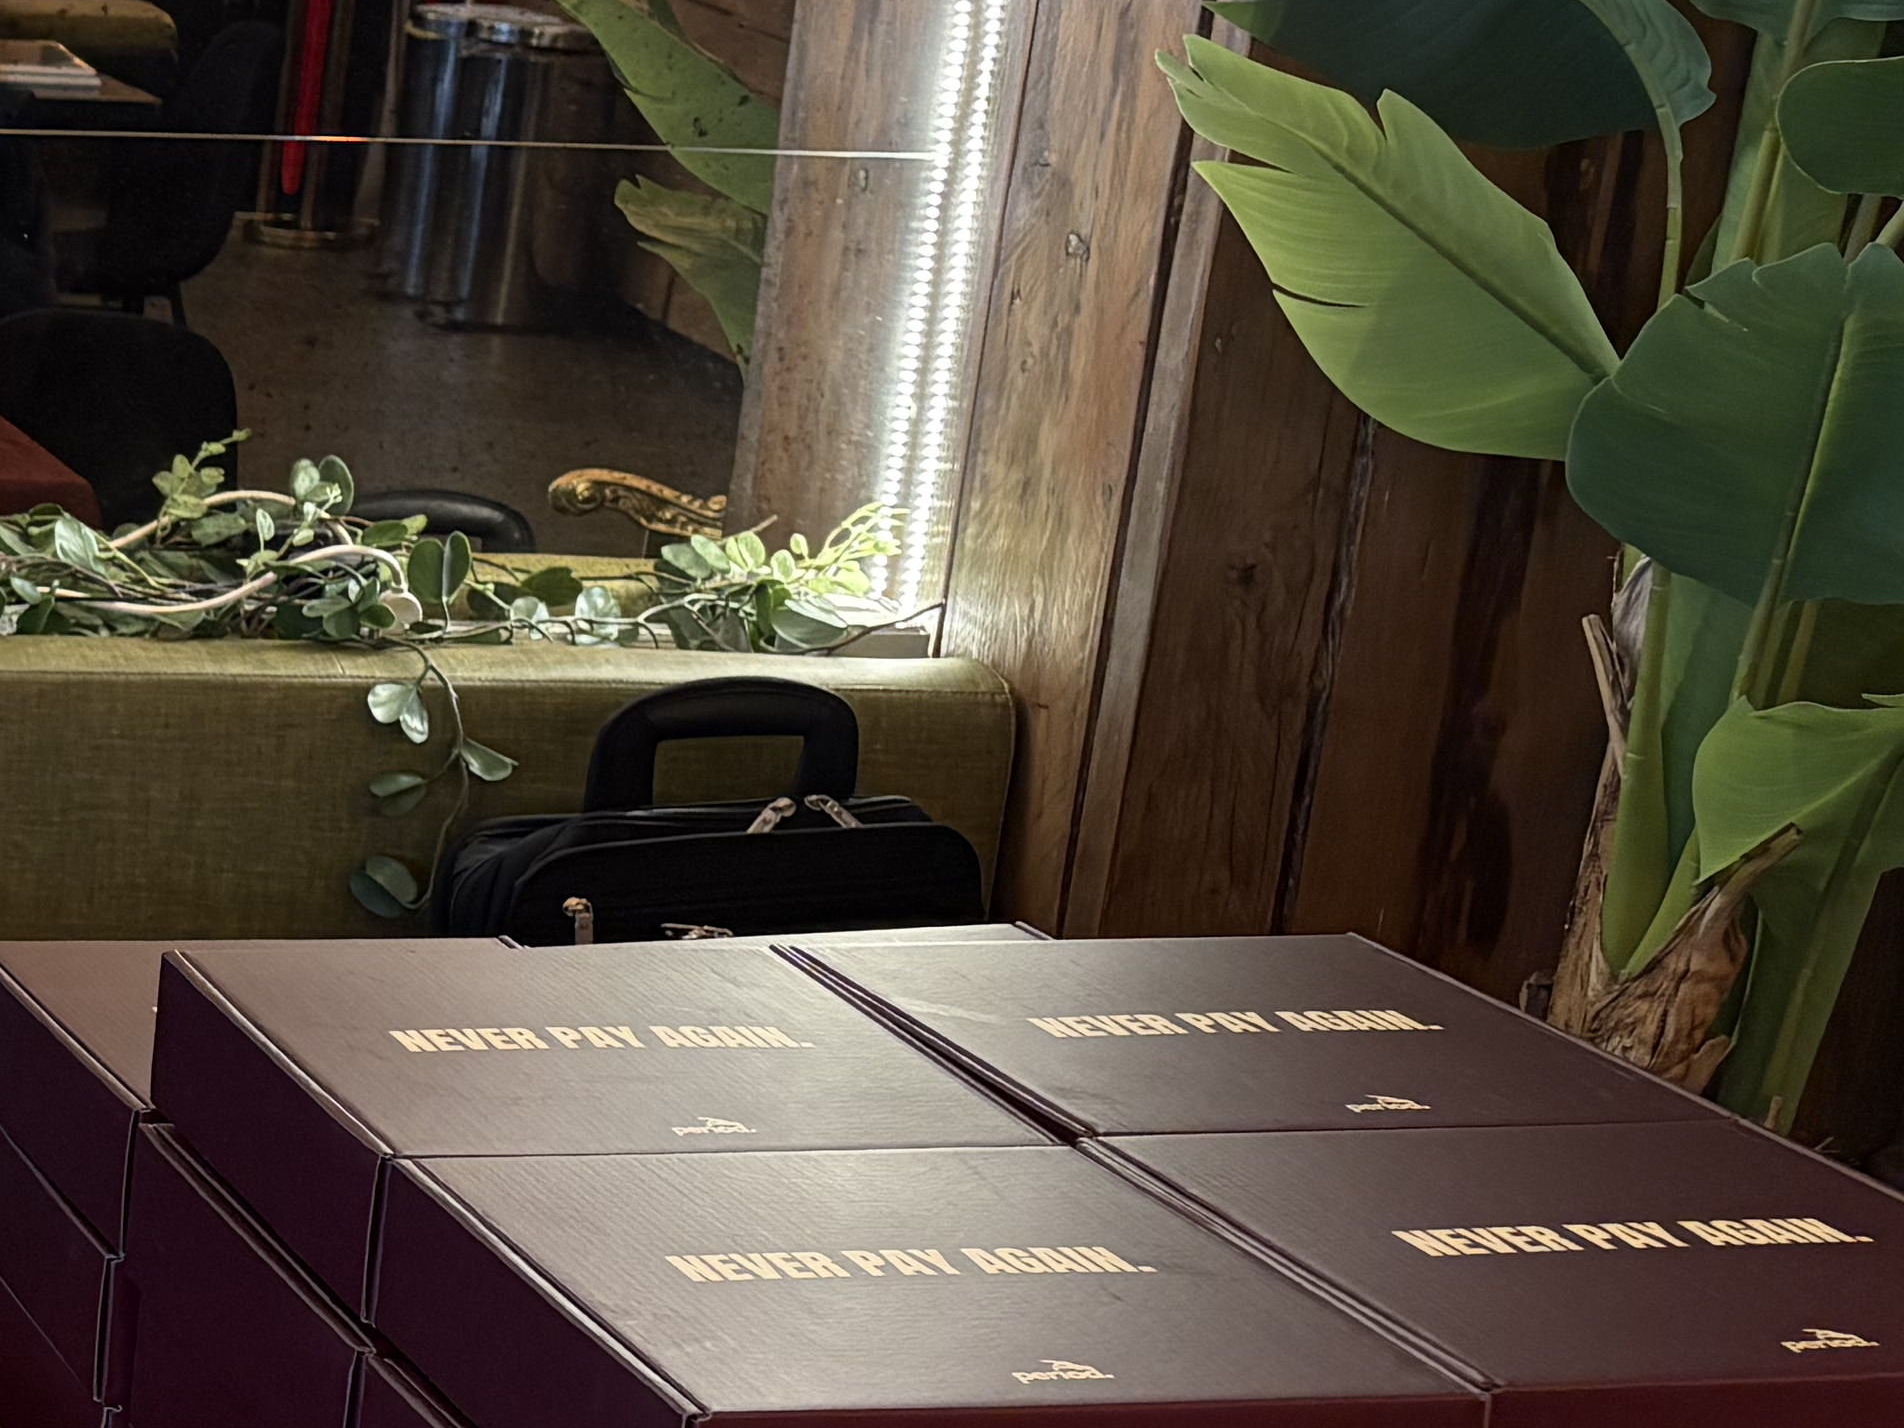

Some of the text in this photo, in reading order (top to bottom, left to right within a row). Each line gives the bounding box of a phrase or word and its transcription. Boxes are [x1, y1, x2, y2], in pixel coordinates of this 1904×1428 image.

[388, 1026, 813, 1053] NEVER PAY AGAIN.
[1028, 1009, 1445, 1038] NEVER PAY AGAIN.
[1391, 1218, 1874, 1257] NEVER PAY AGAIN.
[665, 1246, 1157, 1282] NEVER PAY AGAIN.
